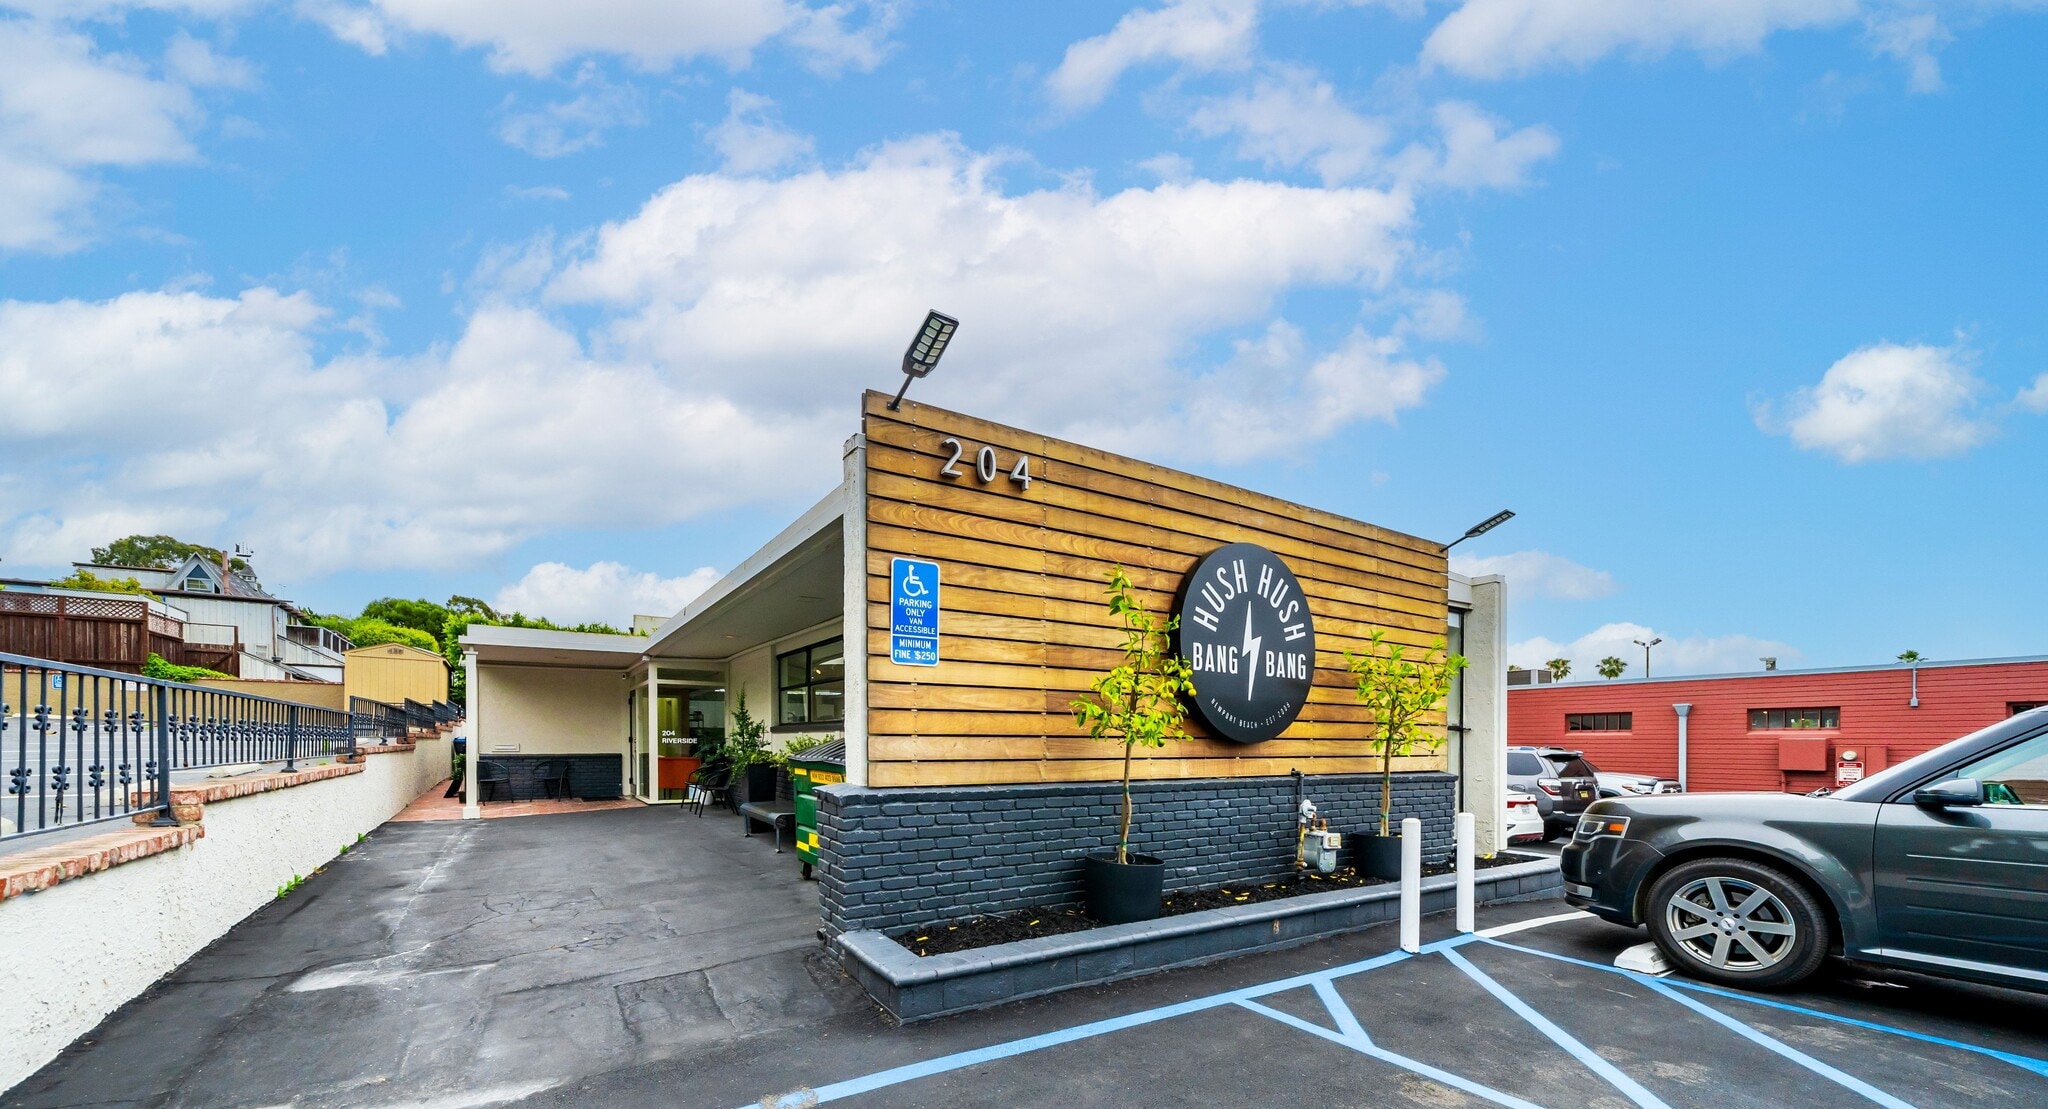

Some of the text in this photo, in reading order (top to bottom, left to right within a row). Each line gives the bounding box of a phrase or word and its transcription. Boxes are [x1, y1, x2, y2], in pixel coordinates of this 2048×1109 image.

[940, 438, 1032, 492] 204
[898, 597, 932, 609] PARKING
[1192, 558, 1306, 642] HUSH HUSH
[905, 608, 926, 617] ONLY
[909, 617, 923, 626] VAN
[895, 624, 936, 635] ACCESSIBLE
[899, 638, 932, 649] MINIMUM
[894, 649, 936, 661] FINE $250
[1192, 642, 1306, 680] BANG BANG
[1211, 697, 1237, 724] NEWPORT
[1239, 719, 1258, 729] BEACH
